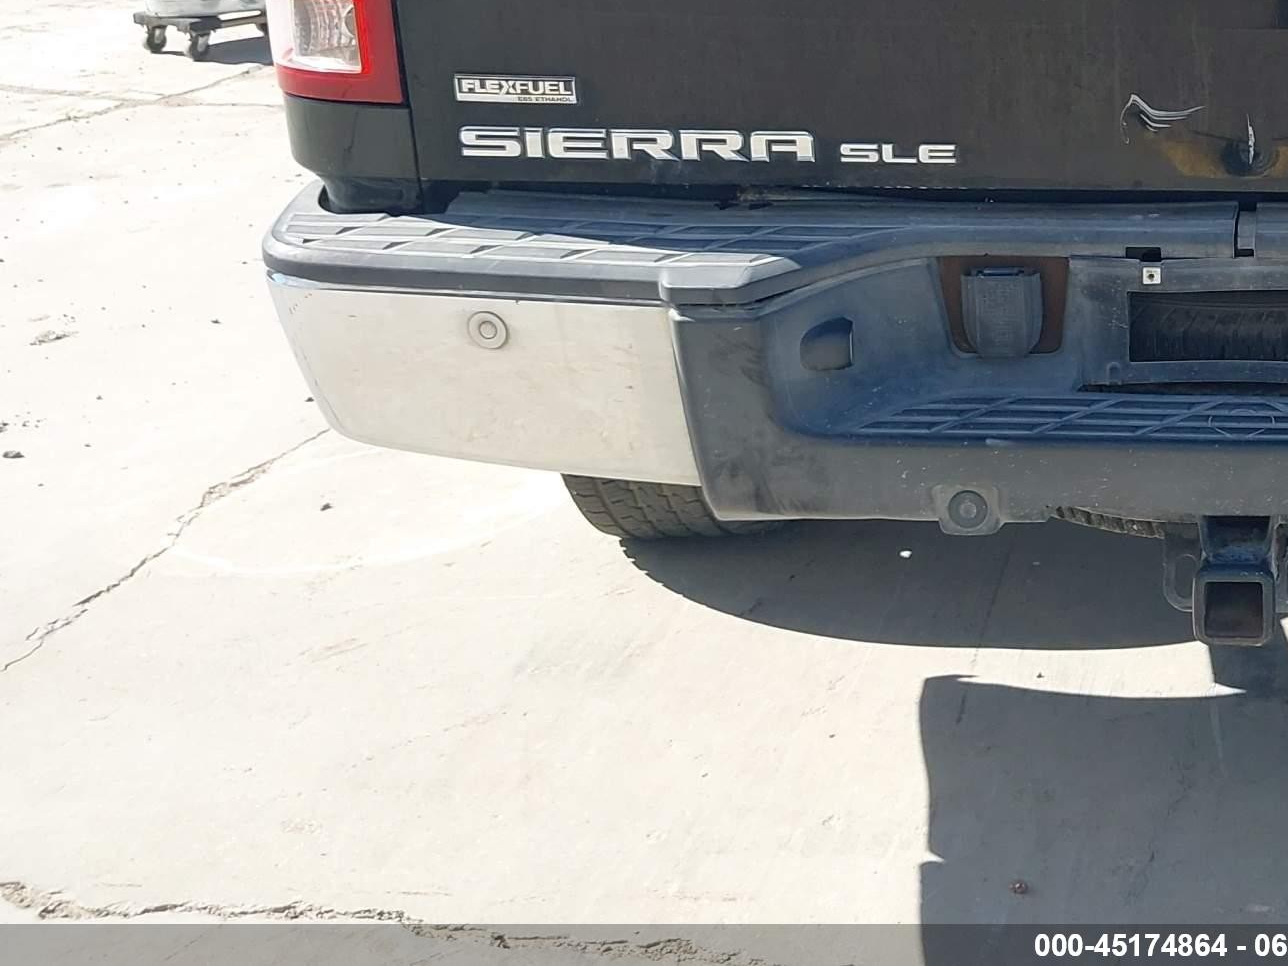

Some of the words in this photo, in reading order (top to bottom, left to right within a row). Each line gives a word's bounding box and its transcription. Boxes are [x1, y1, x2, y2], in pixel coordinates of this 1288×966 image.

[460, 78, 572, 95] FLEXFUEL
[458, 126, 816, 163] SIERRA
[839, 142, 958, 164] SLE
